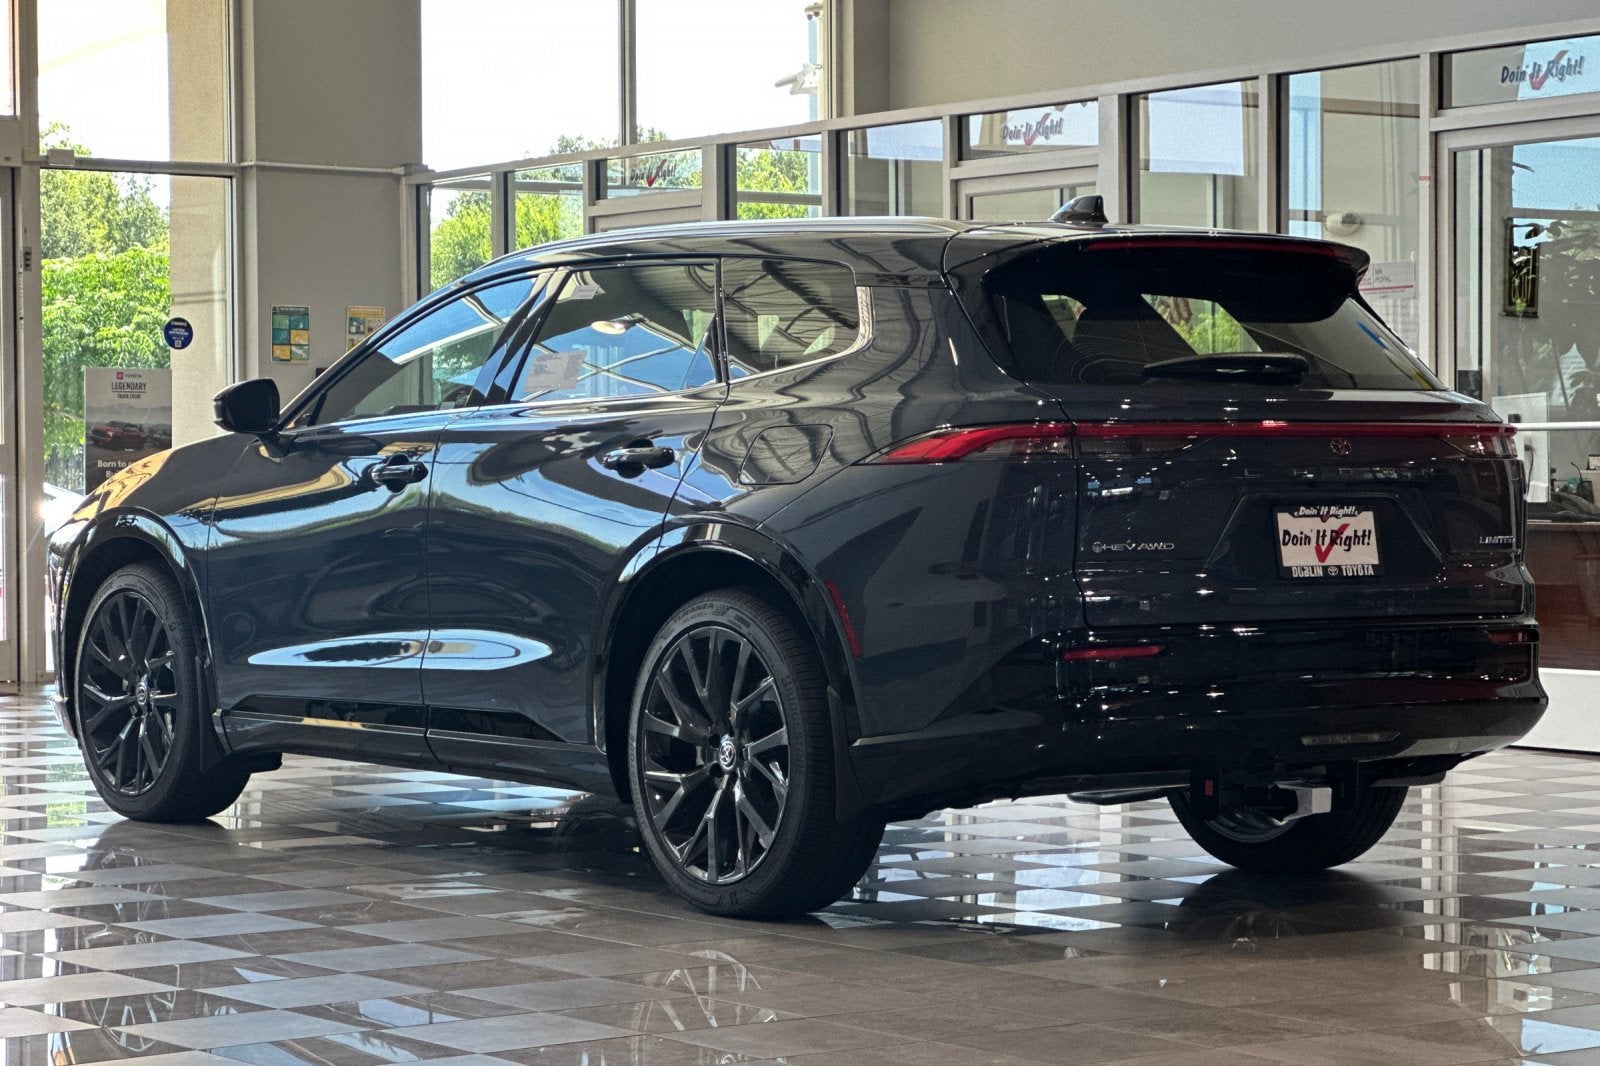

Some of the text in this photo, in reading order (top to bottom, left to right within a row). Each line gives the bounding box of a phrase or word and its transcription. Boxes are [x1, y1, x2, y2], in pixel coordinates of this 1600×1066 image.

[1501, 55, 1585, 83] Doin' It Right!
[111, 381, 147, 391] LEGENDARY
[98, 460, 117, 468] Born
[118, 460, 127, 468] to
[1320, 506, 1328, 515] It
[1329, 506, 1356, 518] Right!
[1316, 529, 1327, 546] It
[1330, 529, 1372, 552] Right!
[1292, 565, 1375, 578] DUBLIN TOYOTA
